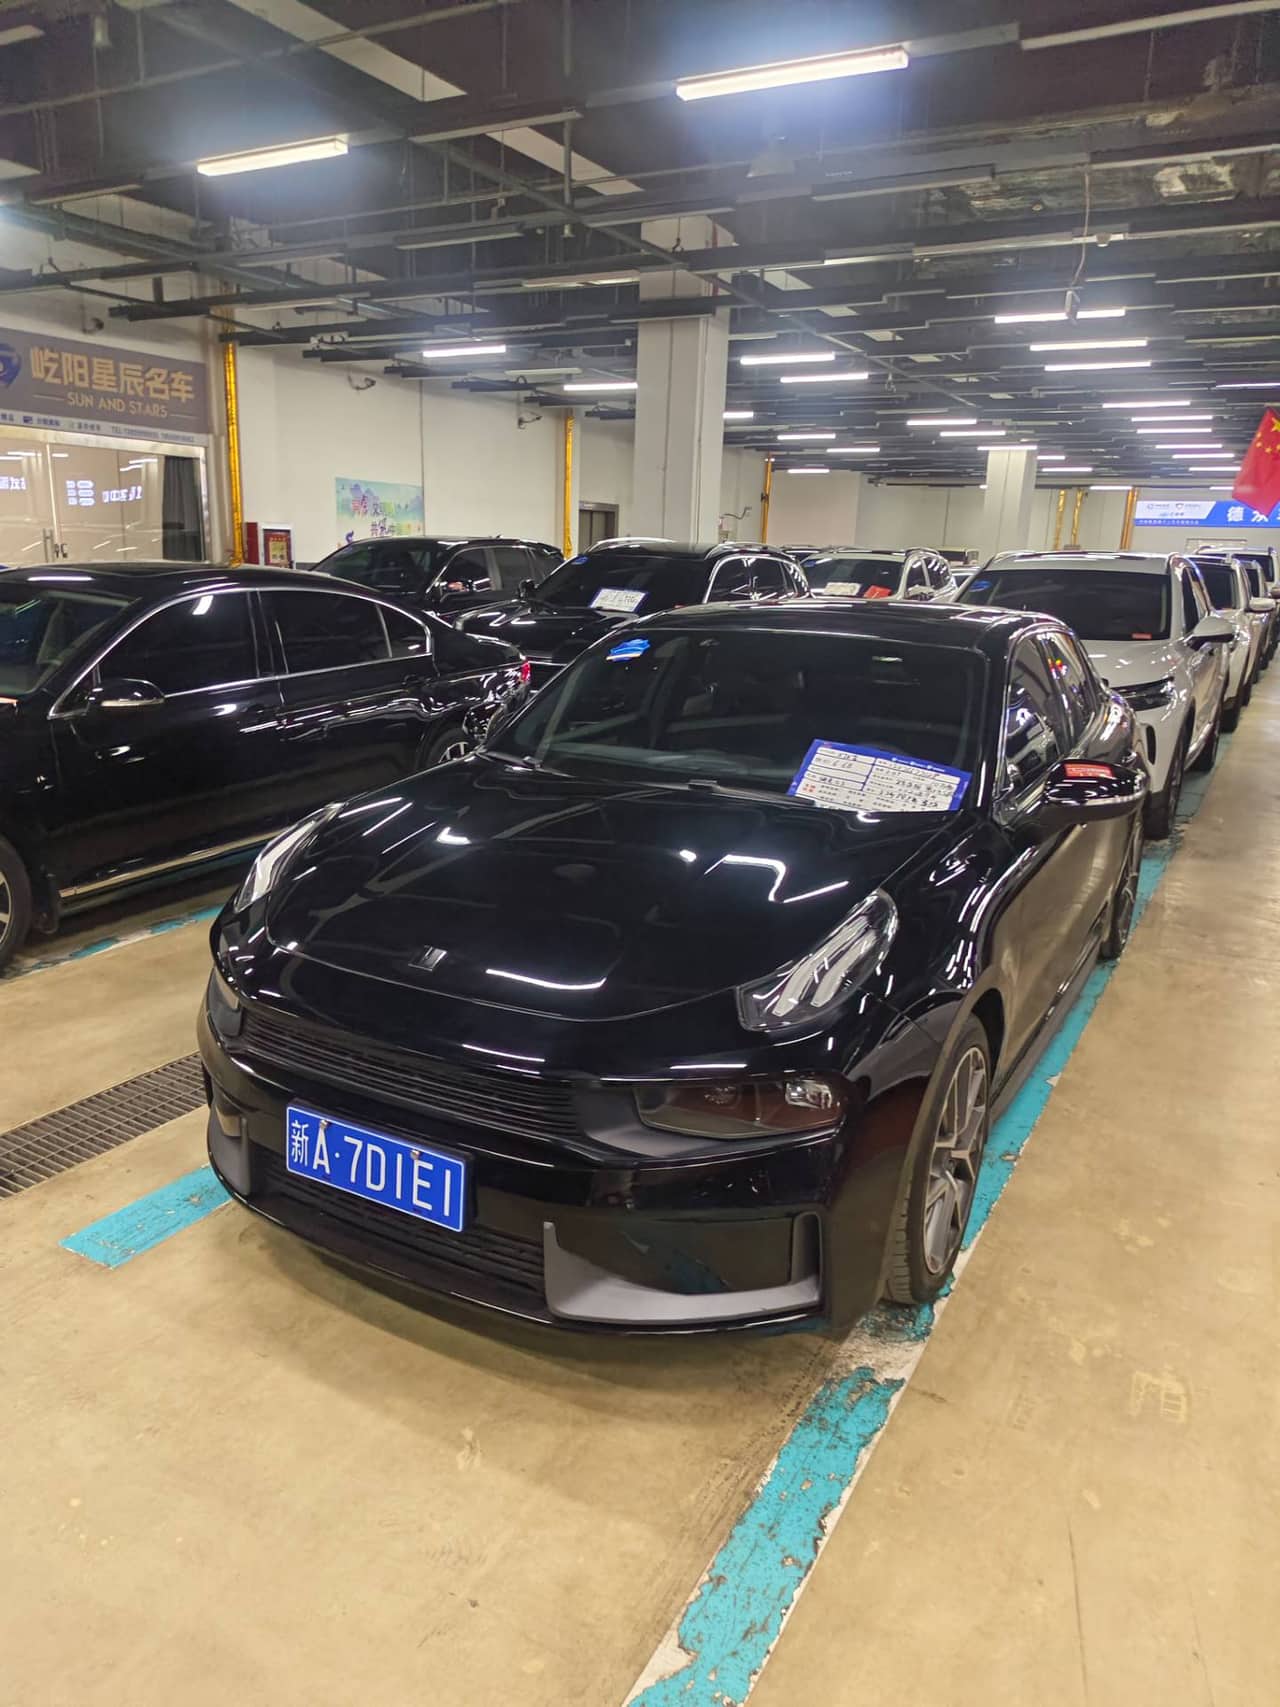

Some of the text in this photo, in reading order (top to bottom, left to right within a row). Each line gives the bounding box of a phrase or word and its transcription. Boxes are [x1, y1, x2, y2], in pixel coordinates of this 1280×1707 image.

[30, 347, 194, 402] 屹阳星辰名车
[67, 392, 168, 419] SUN AND STARS
